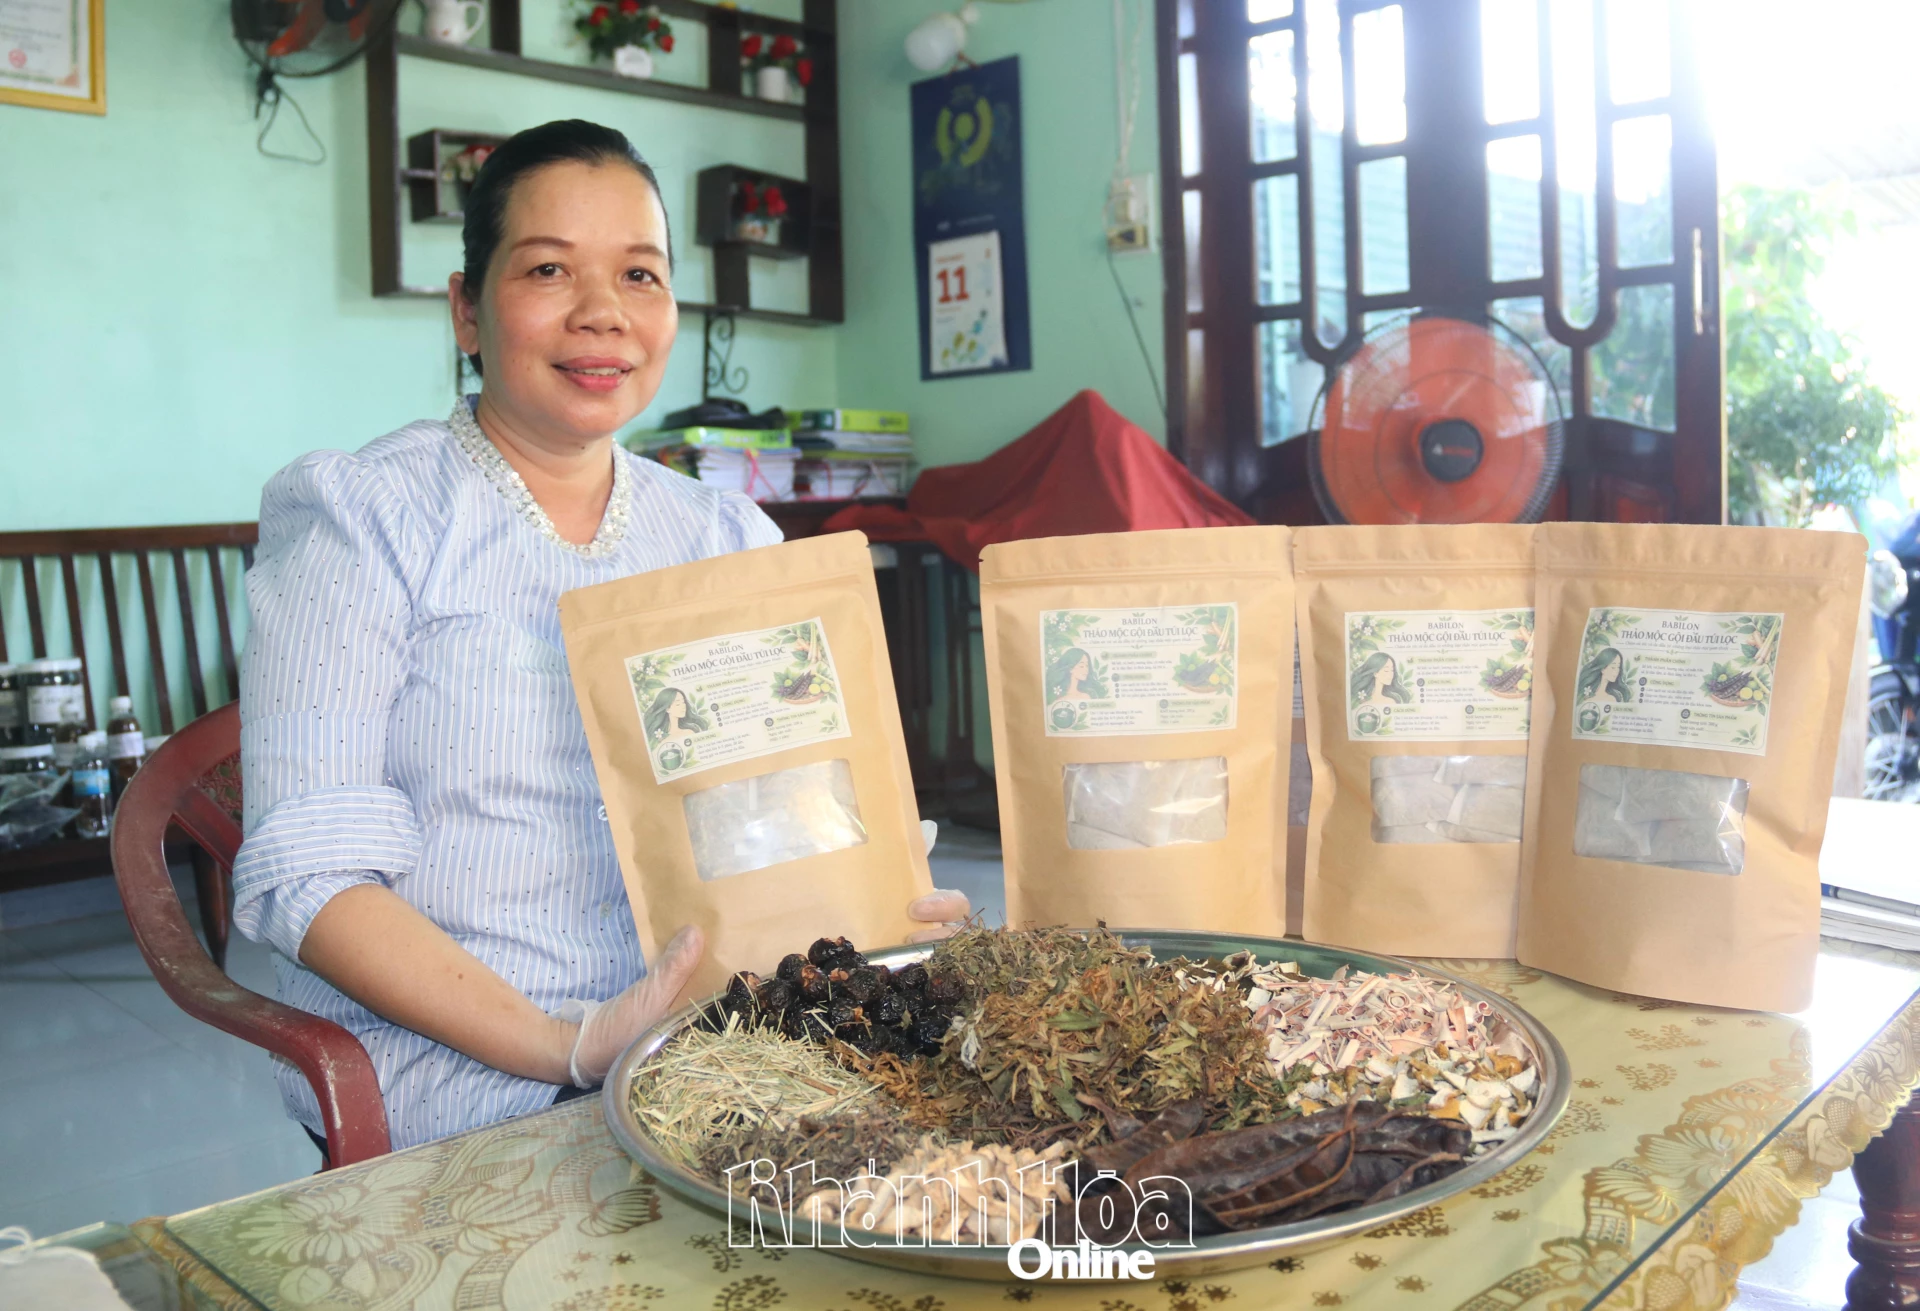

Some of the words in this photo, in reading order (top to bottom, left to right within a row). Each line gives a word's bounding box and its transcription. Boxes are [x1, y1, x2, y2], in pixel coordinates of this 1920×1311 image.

[936, 266, 970, 303] 11
[1121, 618, 1158, 626] BABILON
[1427, 621, 1464, 630] BABILON
[1661, 620, 1700, 631] BABILON
[1108, 627, 1129, 639] MỘC
[1130, 627, 1146, 638] GỘI
[1165, 625, 1180, 636] TÚI
[1181, 626, 1198, 637] LỌC
[1414, 631, 1434, 644] MỘC
[1436, 630, 1452, 643] GỘI
[1472, 630, 1487, 641] TÚI
[1488, 631, 1506, 641] LỌC
[1646, 629, 1667, 642] MỘC
[1668, 631, 1685, 644] GỘI
[1705, 632, 1720, 643] TÚI
[1720, 634, 1738, 645] LỌC
[708, 645, 744, 656] BABILON
[698, 658, 718, 671] MỘC
[719, 655, 734, 666] GỘI
[753, 648, 768, 659] TÚI
[769, 646, 786, 657] LỌC
